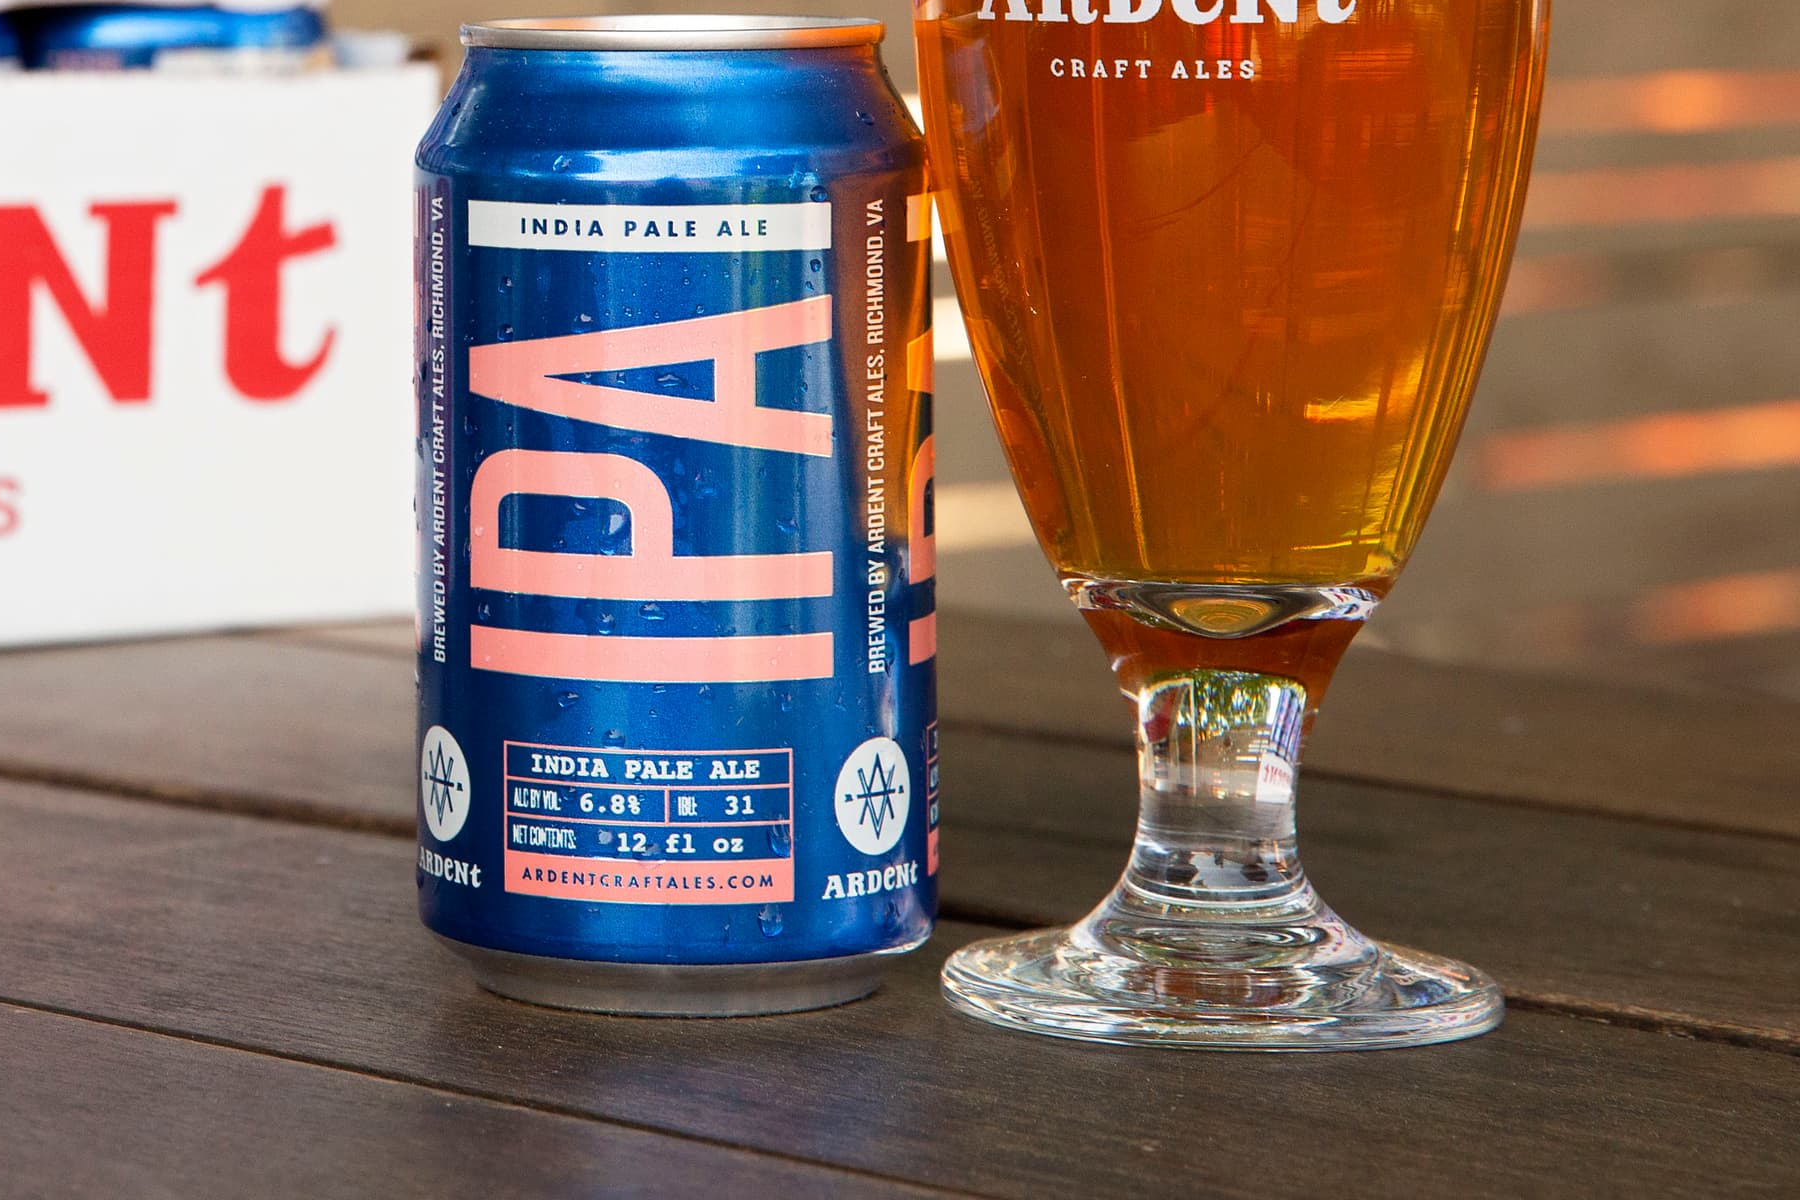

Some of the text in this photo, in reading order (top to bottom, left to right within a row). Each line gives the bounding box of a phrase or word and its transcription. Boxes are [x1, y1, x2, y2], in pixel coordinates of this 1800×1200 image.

[1050, 58, 1256, 80] CRAFT ALES
[431, 196, 444, 222] VA
[521, 217, 768, 238] INDIA PALE ALE
[432, 400, 445, 464] CRAFT
[866, 199, 886, 674] BREWED BY ARDENT CRAFT ALES, RICHMOND, VA
[468, 294, 834, 683] IPA
[432, 467, 446, 546] ARDENT
[433, 549, 445, 580] BY
[433, 582, 446, 663] BREWED
[531, 753, 761, 780] INDIA PALE ALE
[513, 787, 528, 809] ALC
[530, 788, 541, 809] BY
[579, 792, 641, 815] 6.8%
[725, 795, 755, 815] 31
[512, 824, 528, 844] NET
[617, 832, 646, 853] 12
[665, 833, 696, 853] fl
[712, 837, 744, 853] oz
[521, 866, 774, 890] ARDENTCRAFTALES.COM
